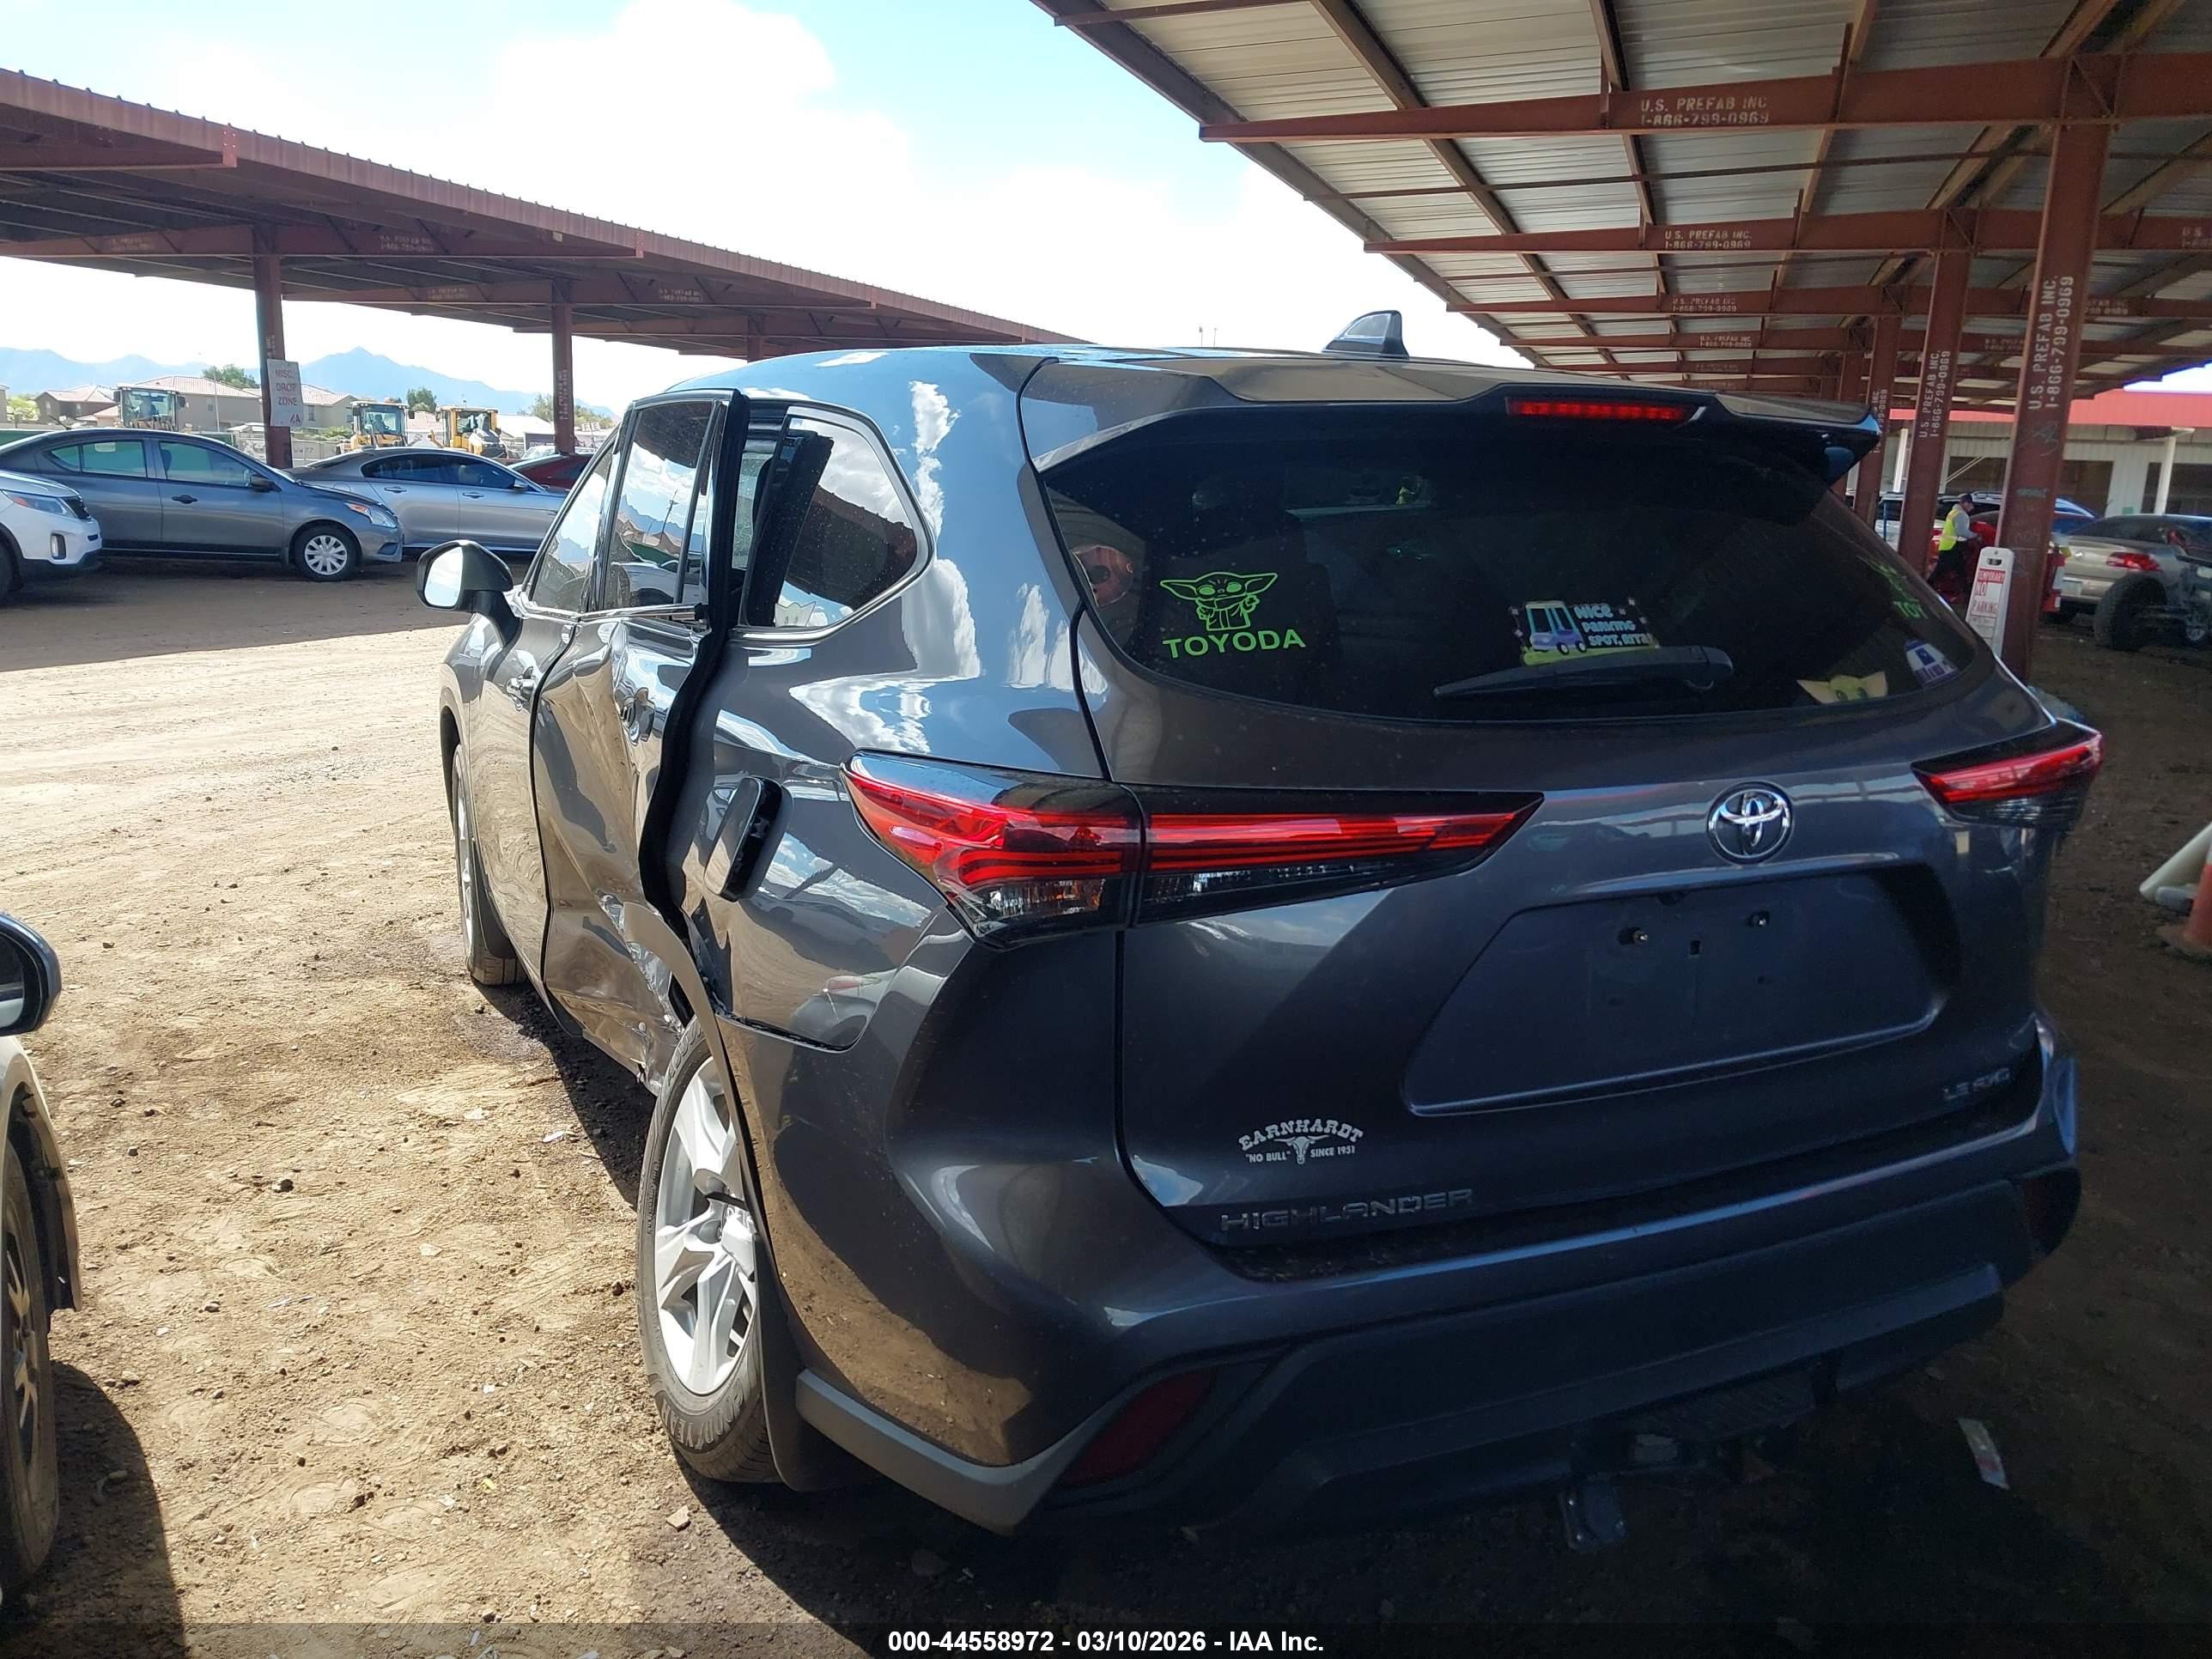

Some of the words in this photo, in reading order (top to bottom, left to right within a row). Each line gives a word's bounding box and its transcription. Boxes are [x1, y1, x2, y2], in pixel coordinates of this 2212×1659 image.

[1641, 98, 1668, 112] U.S.
[1677, 96, 1736, 111] PREFAB
[1689, 229, 1729, 240] PREFAB
[2040, 275, 2058, 305] INC.
[2033, 313, 2053, 372] PREFAB
[2045, 276, 2075, 408] 1-866-799-0969
[1929, 349, 1942, 369] INC.
[276, 382, 297, 392] DROP
[277, 396, 298, 406] ZONE
[1922, 374, 1937, 414] PREFAB
[1929, 350, 1951, 437] 1-866-799-0969
[2027, 380, 2045, 410] U.S.
[1918, 418, 1930, 438] U.S.
[1975, 582, 1986, 596] NO
[1162, 629, 1306, 659] TOYODA
[1238, 1118, 1364, 1151] EARNHARDT
[1245, 1153, 1263, 1163] "NO
[1266, 1151, 1291, 1162] BULL"
[1310, 1146, 1334, 1158] SINCE
[1337, 1145, 1356, 1155] 1951
[1220, 1188, 1474, 1232] HIGHLANDER
